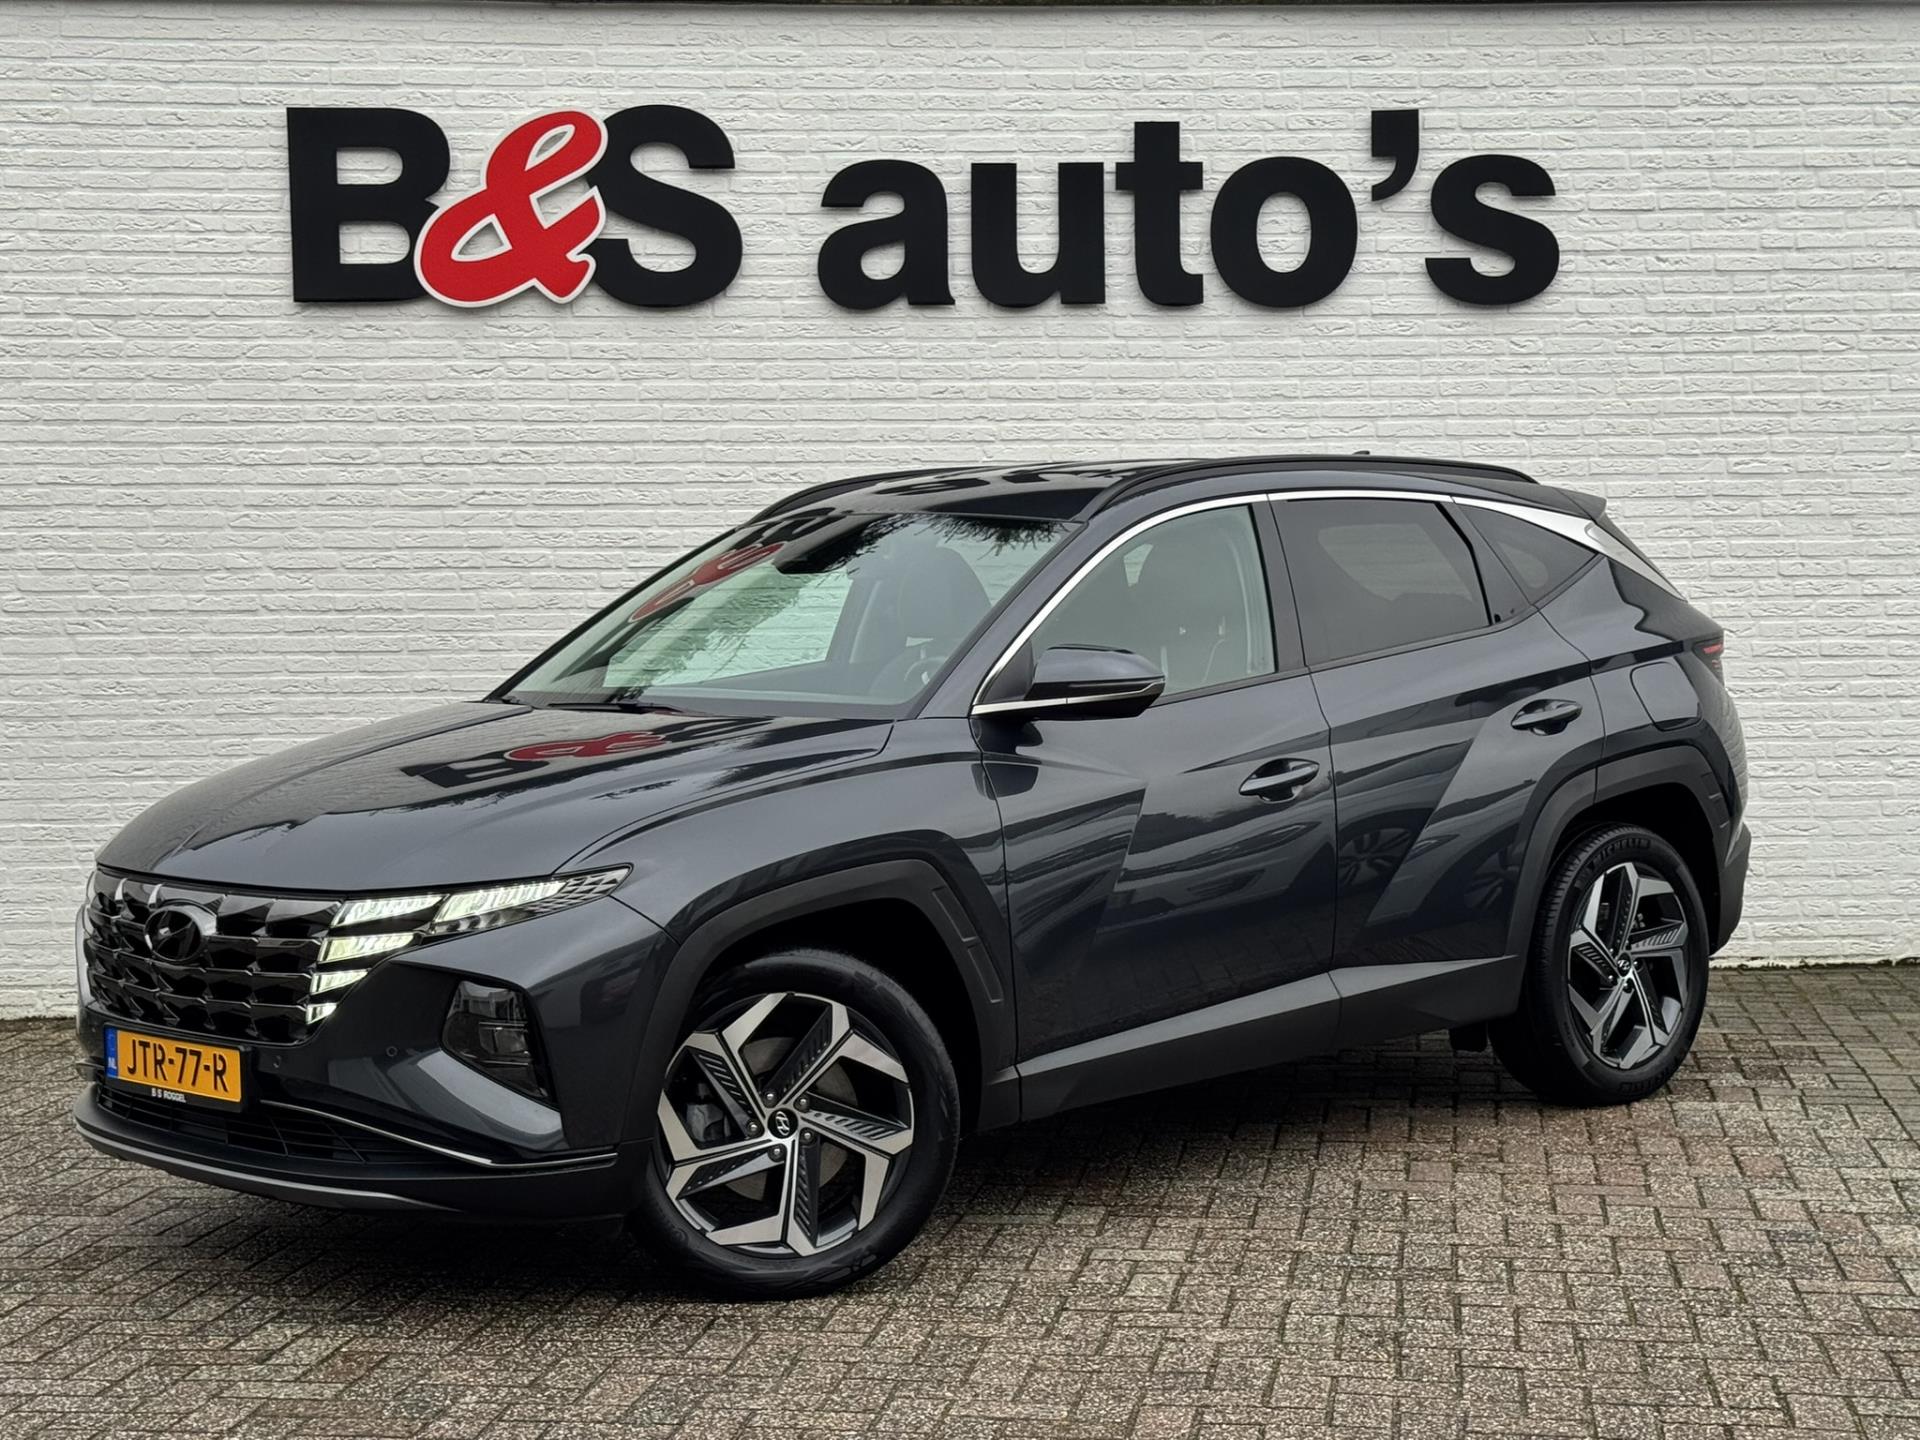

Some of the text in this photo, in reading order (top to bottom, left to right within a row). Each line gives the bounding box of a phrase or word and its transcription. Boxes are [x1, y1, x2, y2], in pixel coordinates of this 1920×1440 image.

[286, 104, 1559, 309] B&S auto's
[127, 1039, 228, 1092] JTR-77-R
